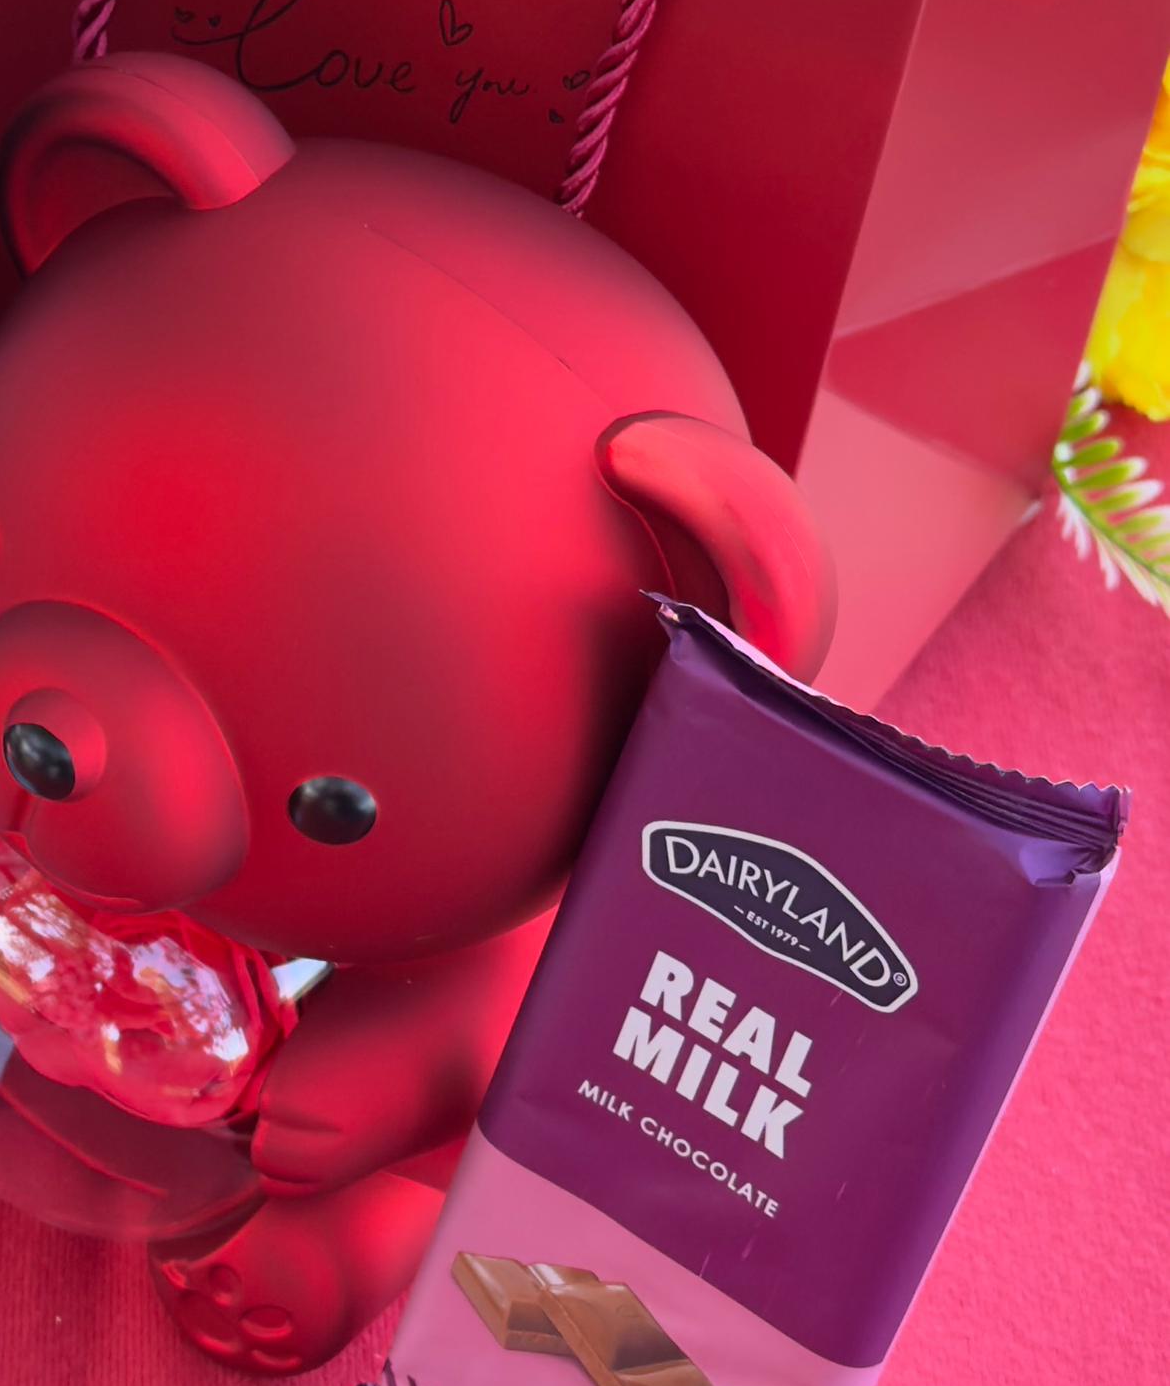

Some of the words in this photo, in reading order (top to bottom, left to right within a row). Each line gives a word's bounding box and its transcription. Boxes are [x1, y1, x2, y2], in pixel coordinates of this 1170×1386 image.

[449, 67, 533, 125] you
[665, 835, 892, 988] DAIRYLAND
[746, 911, 770, 931] EST
[770, 924, 799, 946] 1979
[612, 1005, 805, 1160] MILK
[639, 949, 813, 1099] REAL
[577, 1079, 634, 1122] MILK
[639, 1116, 779, 1219] CHOCOLATE
